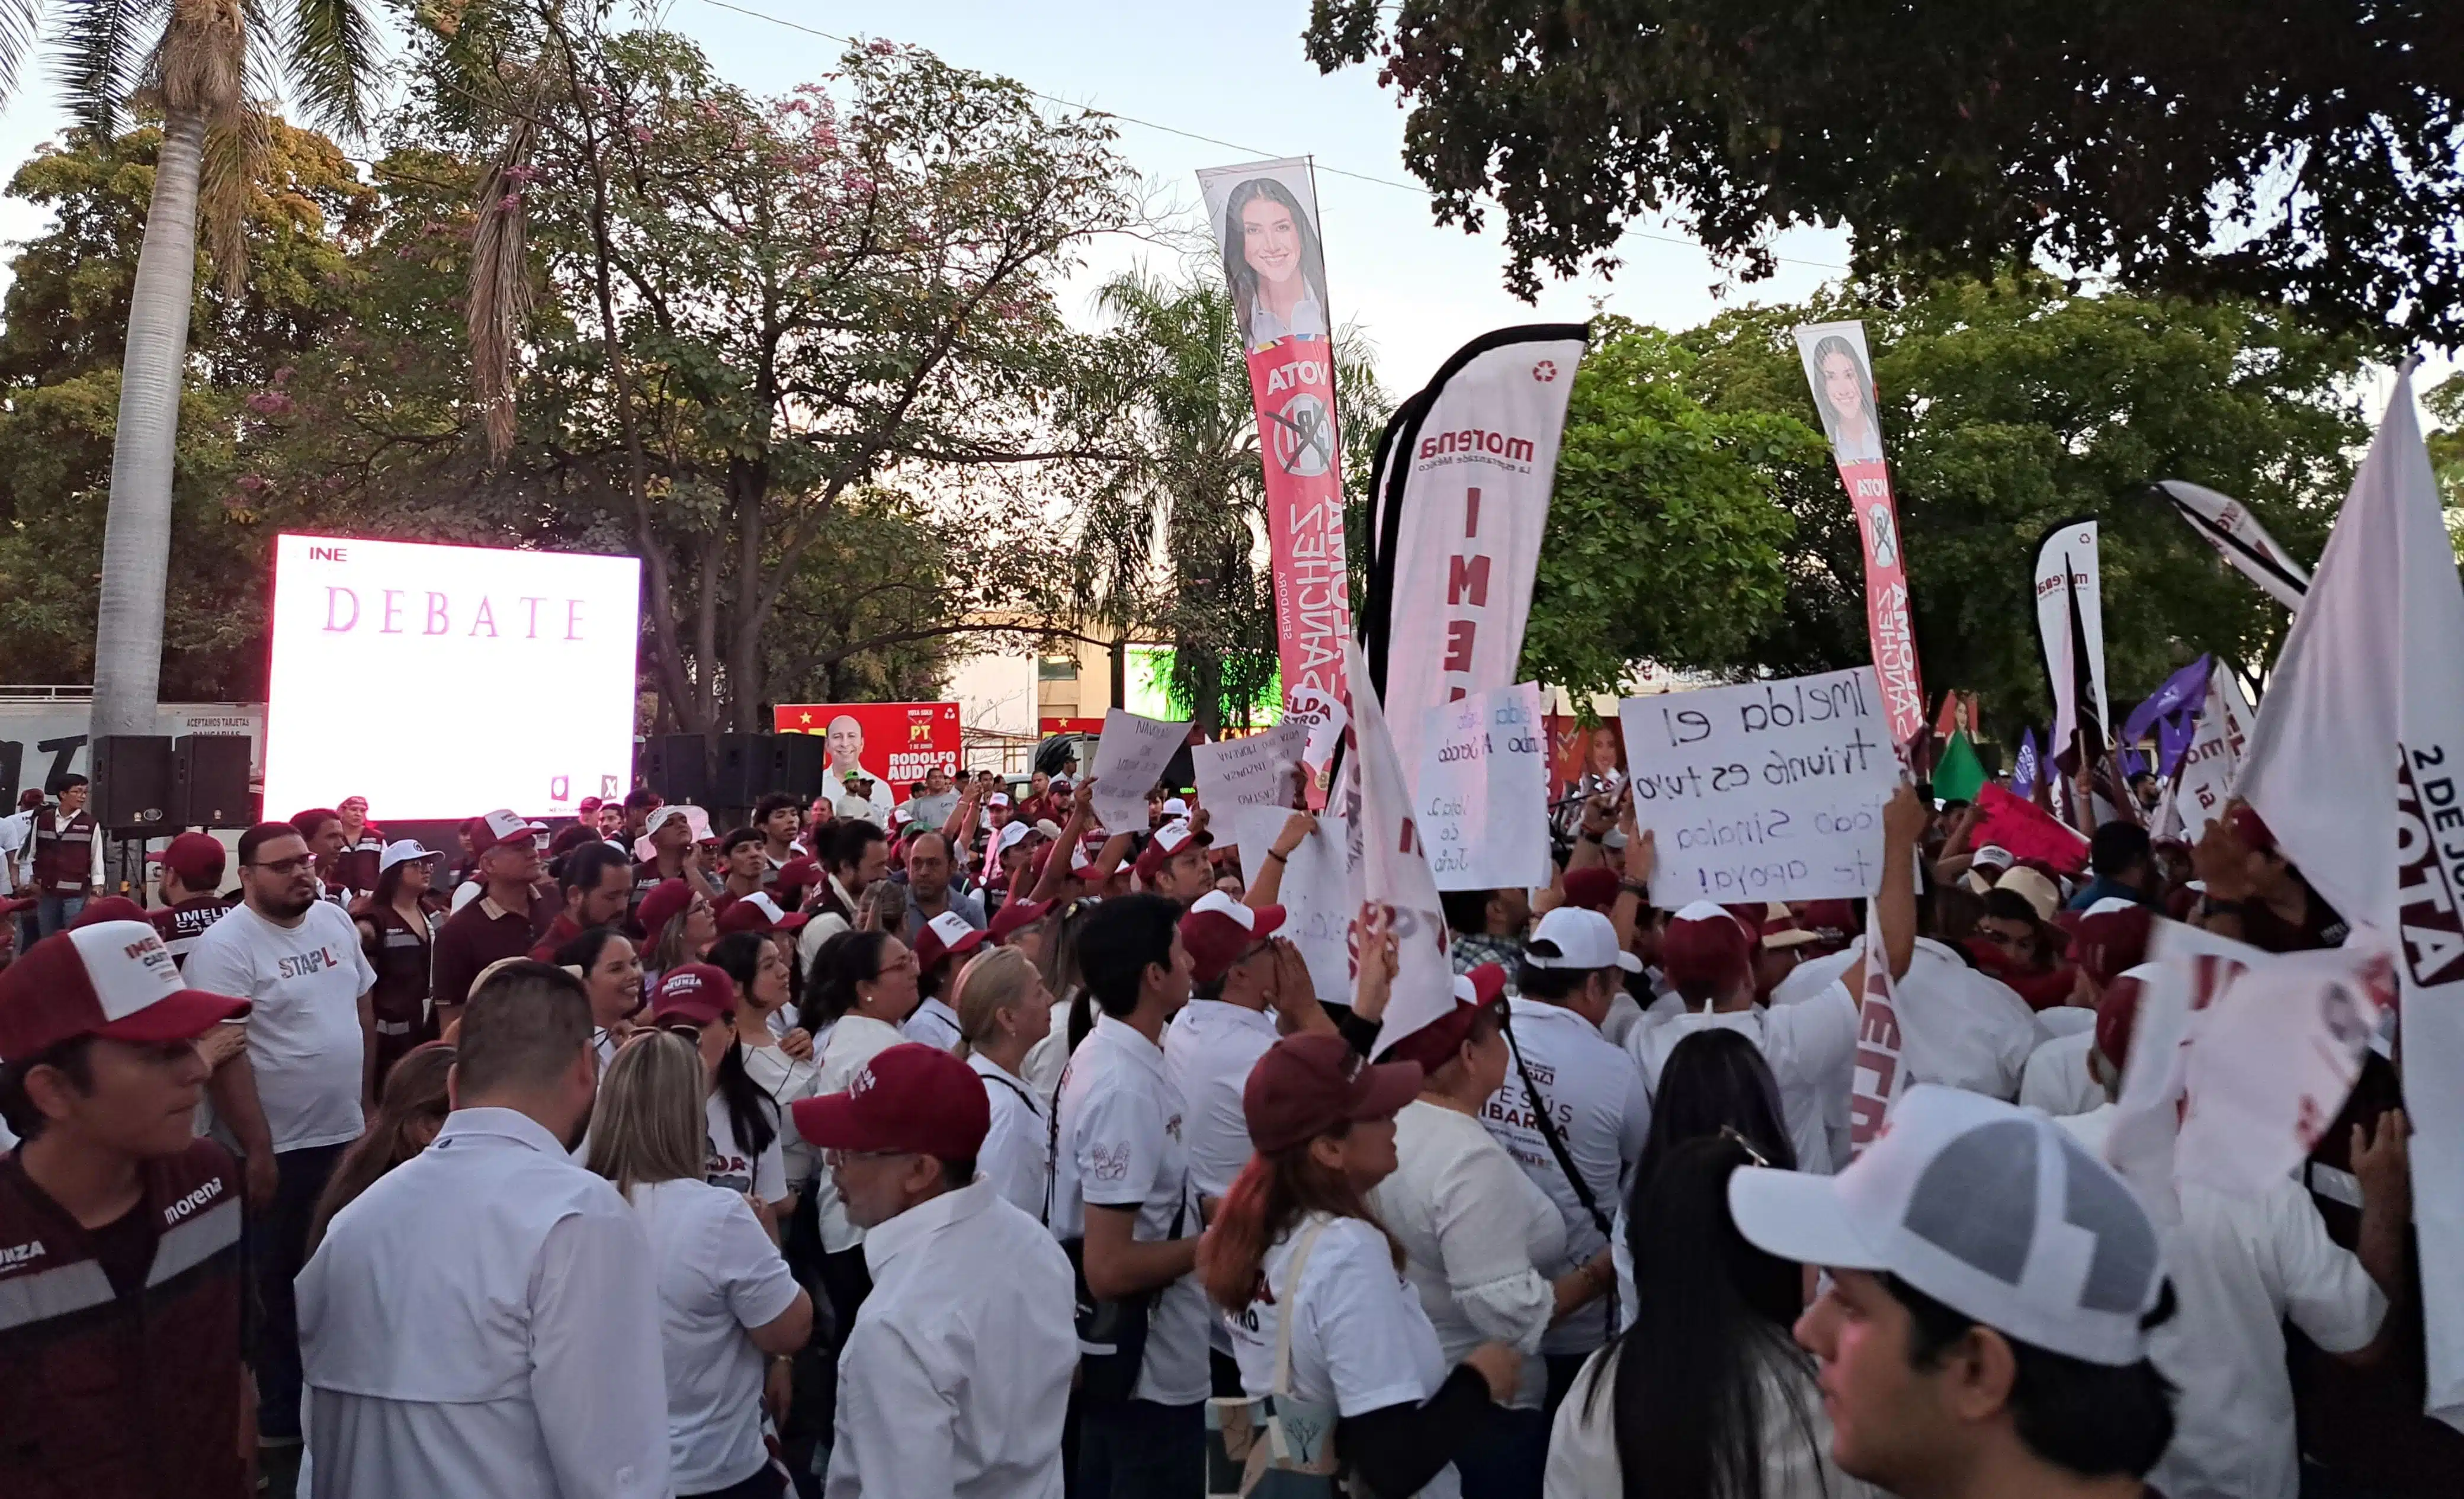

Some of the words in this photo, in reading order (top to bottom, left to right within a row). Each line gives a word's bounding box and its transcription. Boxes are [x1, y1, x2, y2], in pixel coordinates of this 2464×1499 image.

[310, 547, 348, 562] INE
[322, 586, 585, 640] DEBATE
[187, 718, 220, 727] ACEPTAMOS
[222, 718, 249, 727] TARJETAS
[910, 725, 931, 740] PT
[889, 750, 957, 766] RODOLFO
[2412, 744, 2444, 770] 2
[2423, 776, 2464, 832] DE
[1500, 1085, 1573, 1124] ESÚS
[1482, 1102, 1570, 1142] IBARA
[164, 1177, 223, 1225] morena
